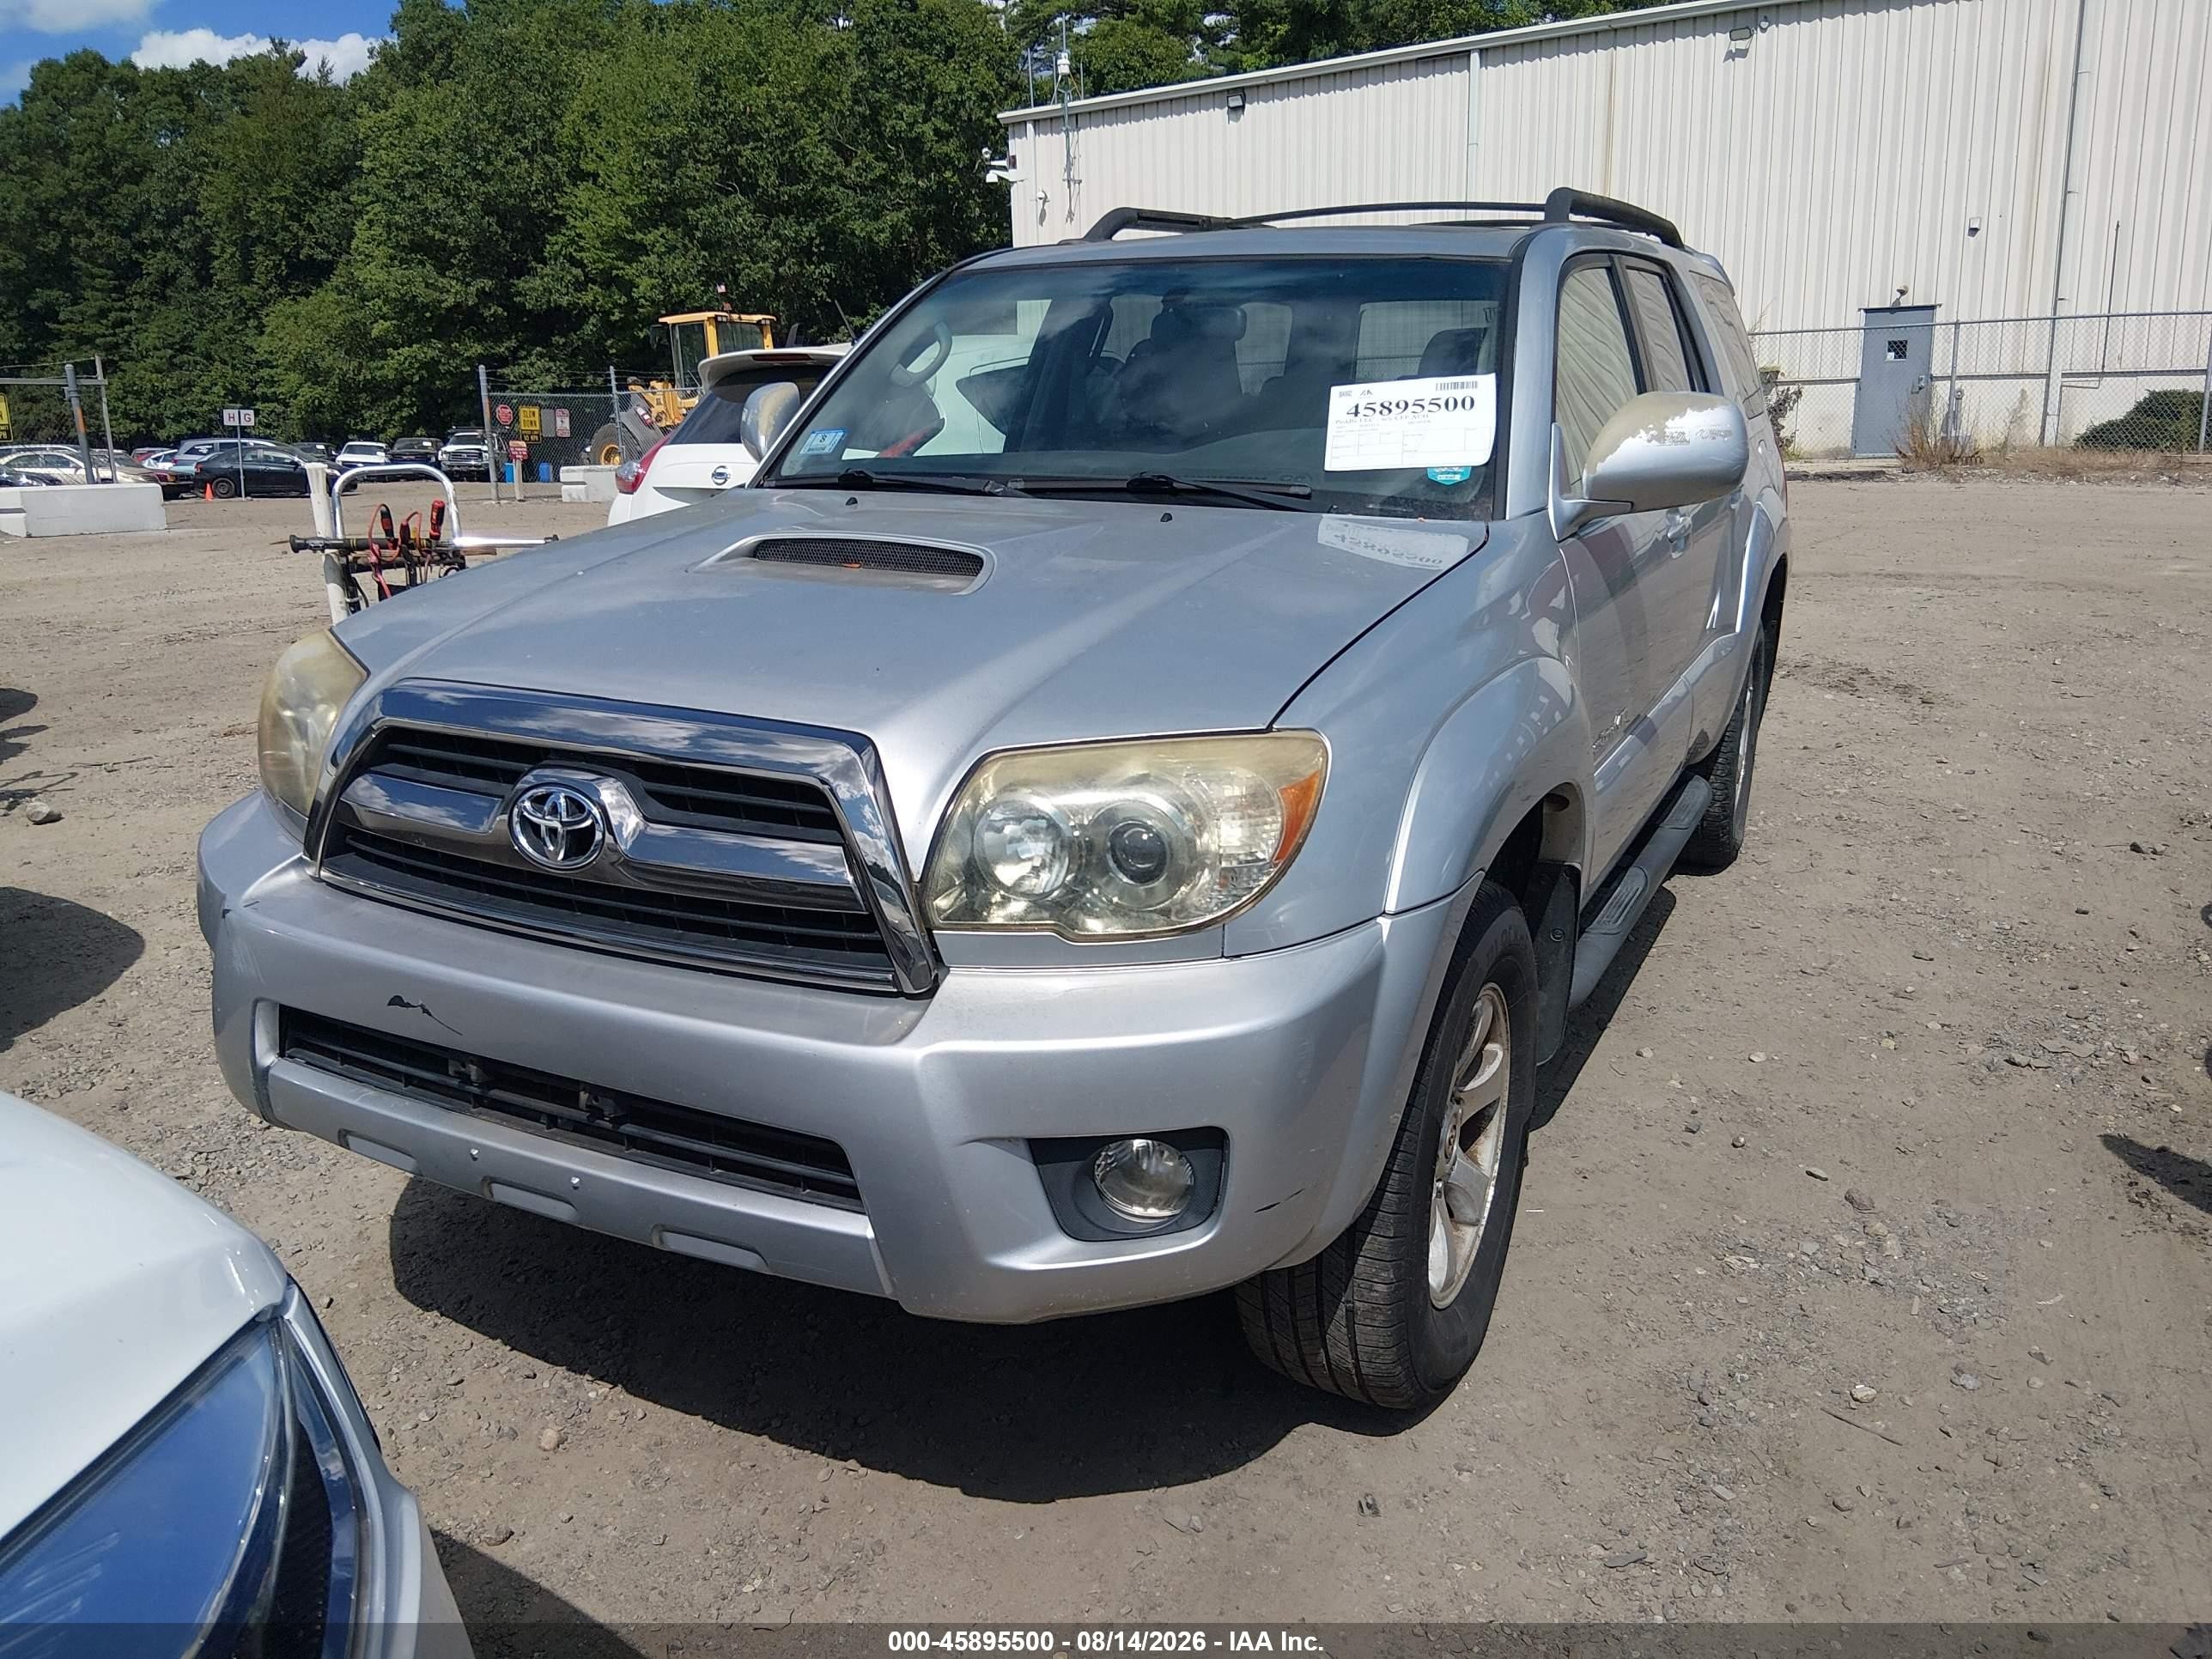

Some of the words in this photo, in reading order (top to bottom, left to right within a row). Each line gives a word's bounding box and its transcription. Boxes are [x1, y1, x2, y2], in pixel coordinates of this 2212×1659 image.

[1346, 395, 1475, 418] 45895500
[228, 413, 235, 422] H
[244, 413, 252, 422] G
